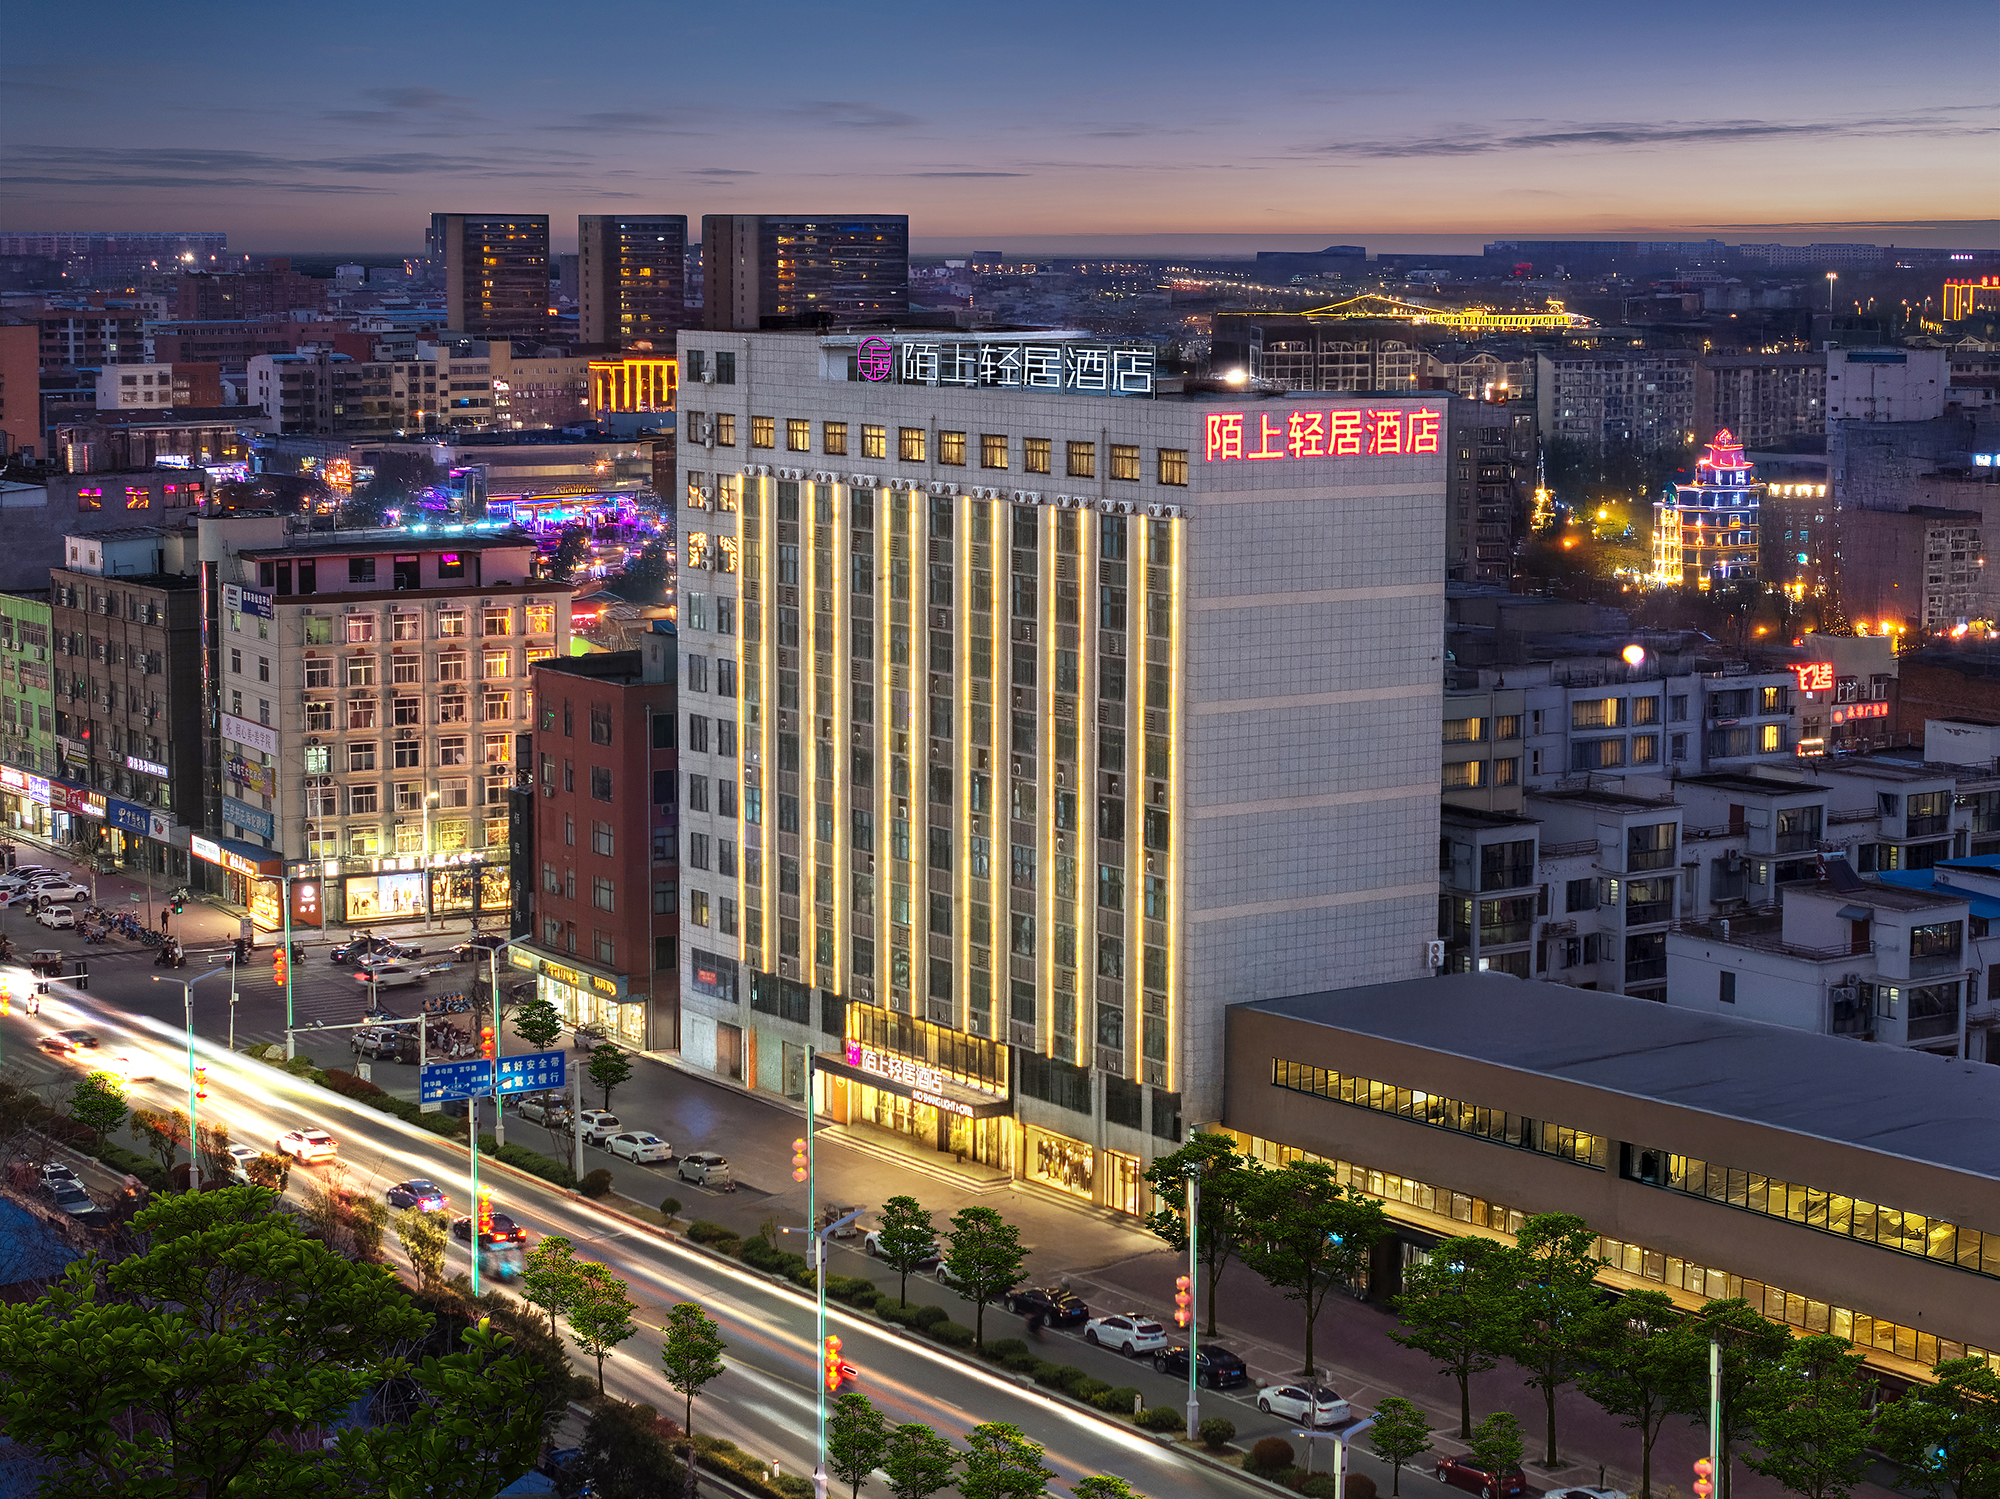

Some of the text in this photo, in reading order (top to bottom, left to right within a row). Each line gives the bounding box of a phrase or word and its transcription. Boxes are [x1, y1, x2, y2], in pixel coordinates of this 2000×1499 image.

[902, 343, 1154, 393] 陌上轻居酒店
[1205, 407, 1441, 463] 陌上轻居酒店
[501, 1056, 560, 1073] 系好安全带
[862, 1048, 943, 1094] 陌上轻居酒店
